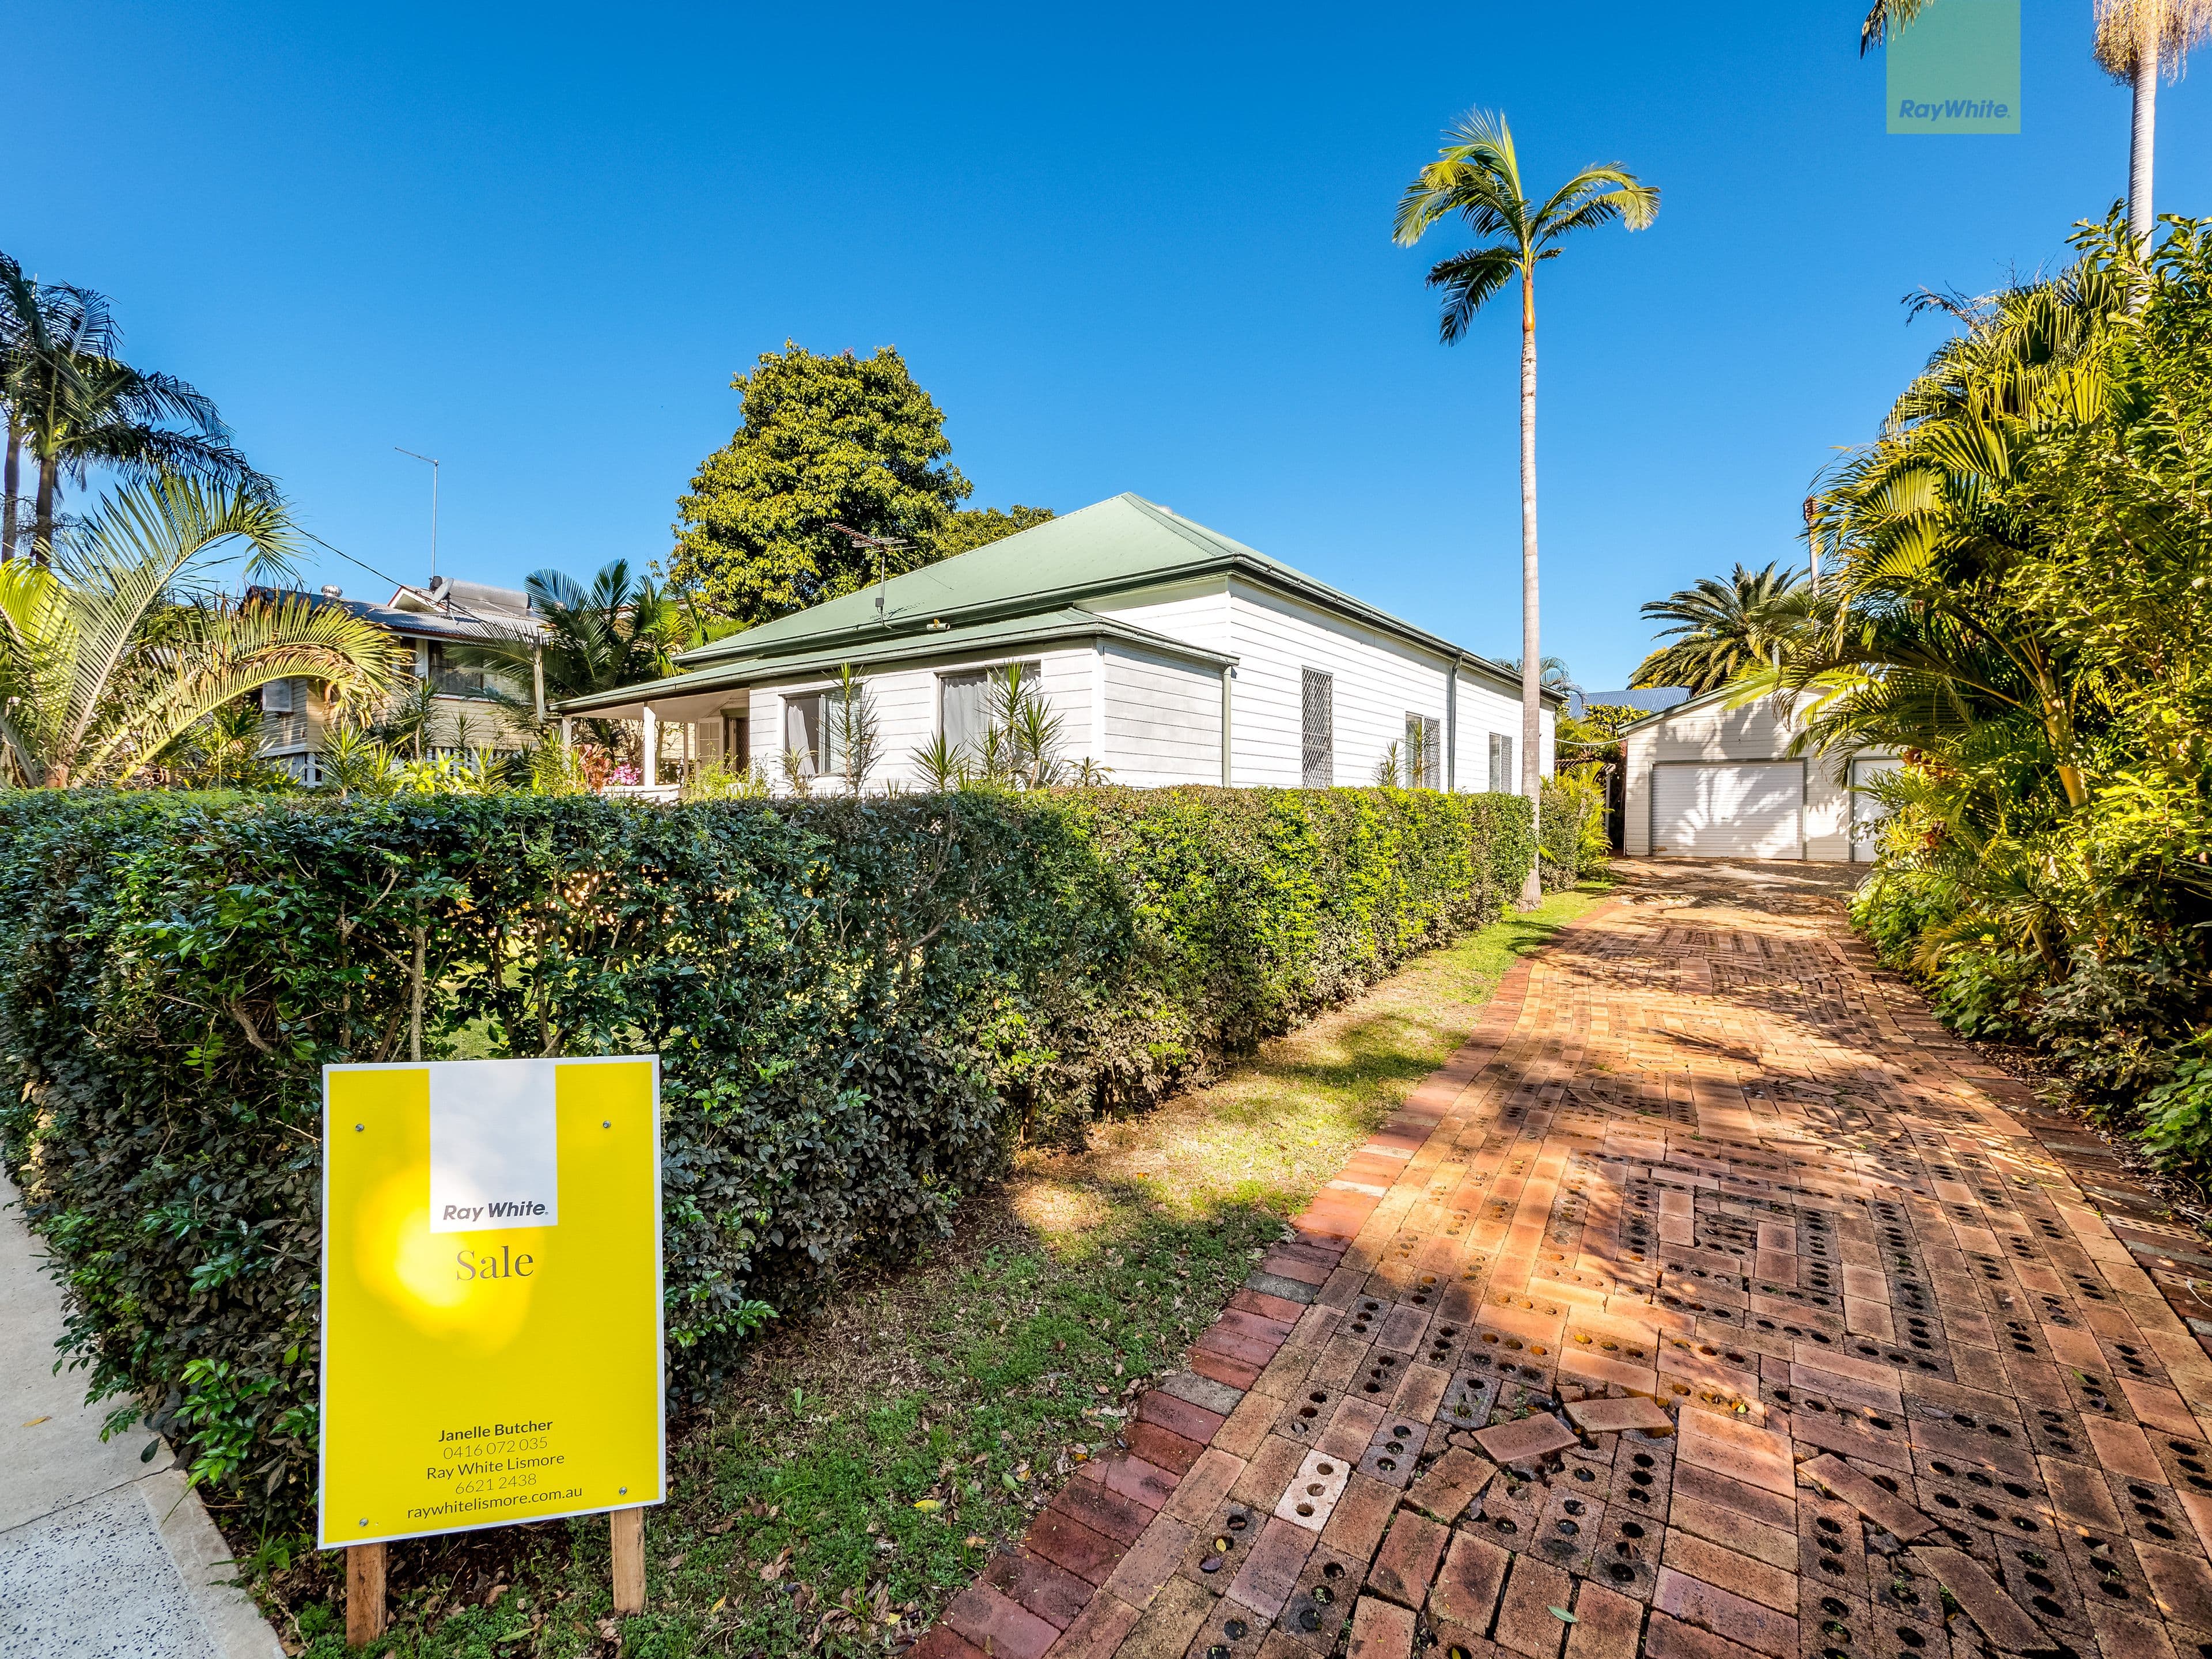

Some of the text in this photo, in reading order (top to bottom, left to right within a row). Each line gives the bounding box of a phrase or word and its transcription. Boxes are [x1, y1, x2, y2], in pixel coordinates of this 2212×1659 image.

[443, 1200, 546, 1222] Ray White
[457, 1245, 534, 1281] Sale
[438, 1419, 554, 1442] Janelle Butcher
[443, 1436, 548, 1460] 0416 072 035
[427, 1453, 565, 1480] Ray White Lismore
[455, 1473, 537, 1494] 6621 2438
[407, 1487, 583, 1519] raywhitelismore.com.au
